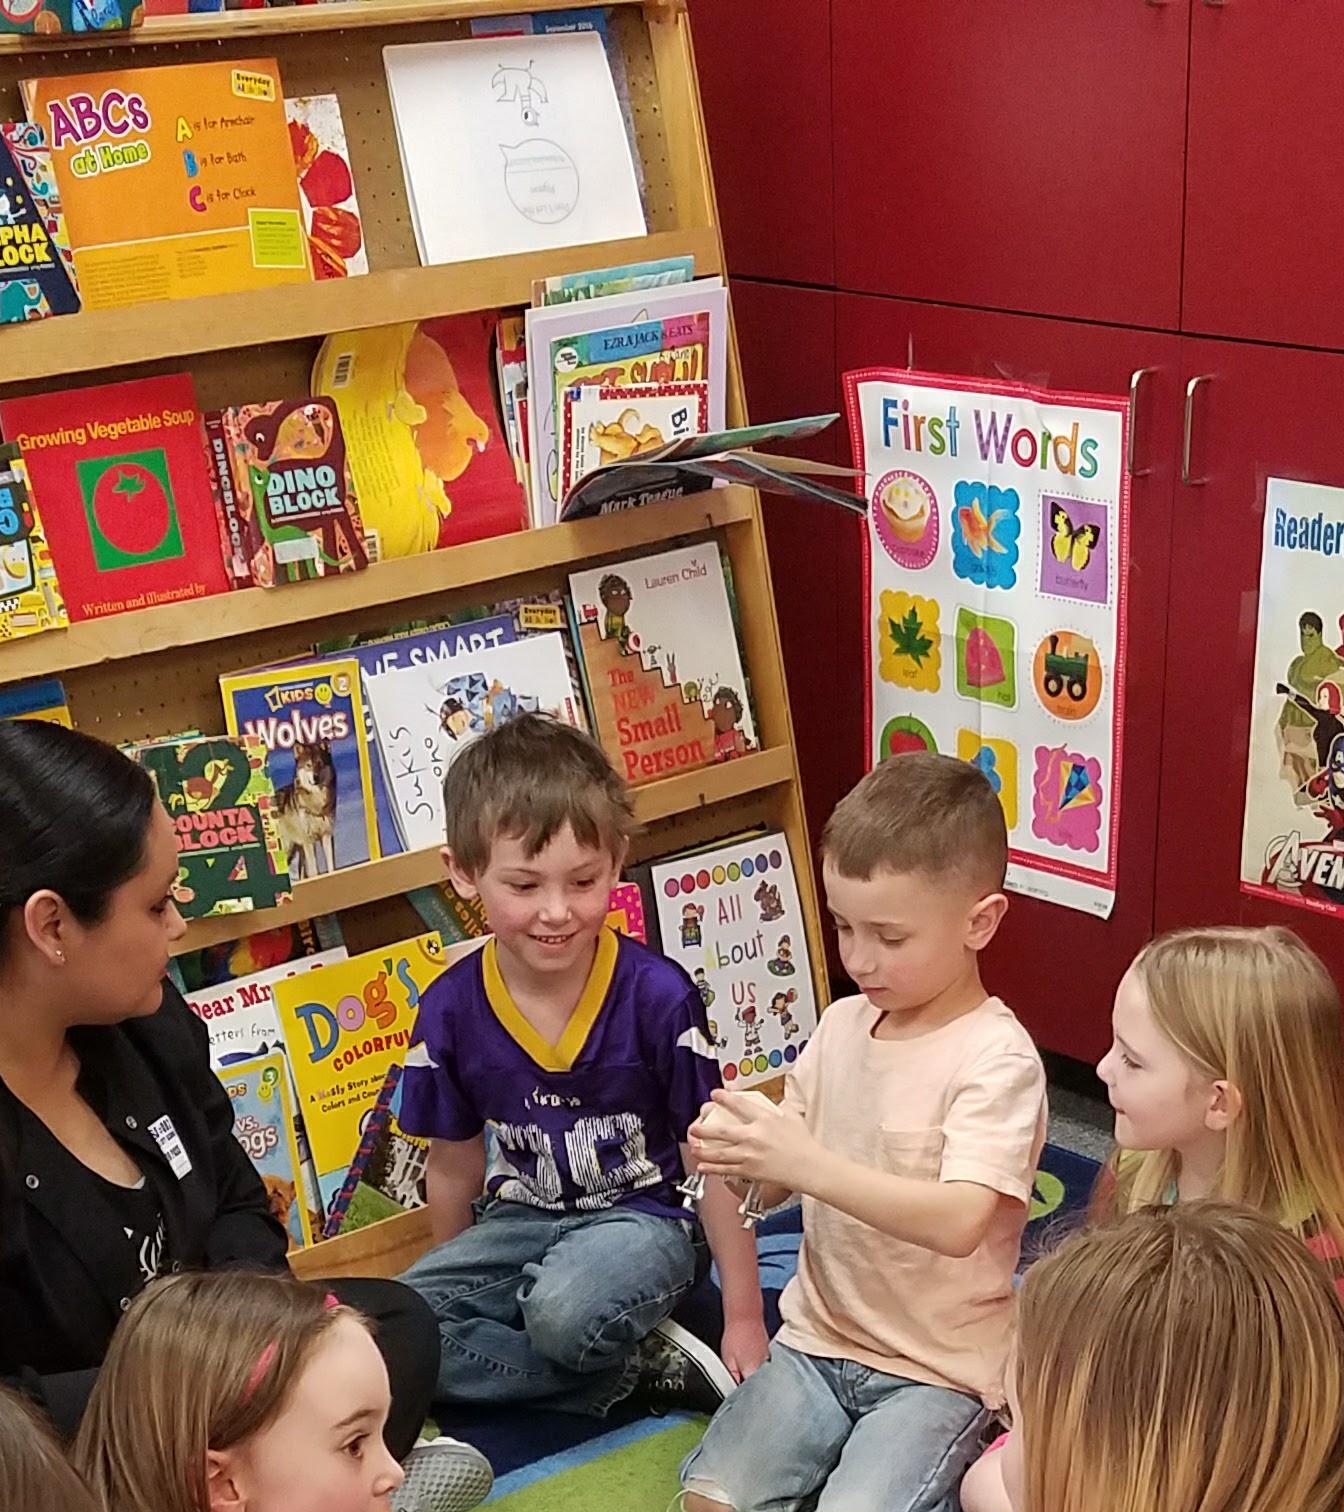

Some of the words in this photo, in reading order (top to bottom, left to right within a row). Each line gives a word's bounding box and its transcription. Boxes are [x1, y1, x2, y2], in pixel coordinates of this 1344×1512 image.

[235, 73, 272, 88] Everyday
[49, 91, 149, 148] ABCs
[176, 116, 193, 143] A
[203, 118, 218, 130] for
[220, 116, 256, 128] Armchair
[73, 150, 96, 175] at
[98, 143, 149, 169] Home
[183, 149, 198, 178] B
[209, 154, 225, 165] for
[226, 151, 248, 163] Bath
[189, 185, 207, 213] C
[216, 190, 231, 202] for
[232, 186, 257, 199] Clock
[603, 333, 632, 350] EZRA
[632, 329, 659, 345] JACK
[662, 323, 693, 341] KEATS
[16, 425, 86, 452] Growing
[86, 412, 161, 442] Vegetable
[162, 407, 196, 430] Soup
[671, 407, 690, 436] Bi
[881, 397, 960, 457] First
[972, 408, 1099, 479] Words
[266, 464, 336, 496] DINO
[268, 486, 342, 516] BLOCK
[600, 494, 637, 514] Mark
[638, 486, 684, 507] Teague
[644, 570, 680, 590] Lauren
[680, 562, 708, 583] Child
[1054, 574, 1090, 592] butterfly
[81, 599, 124, 617] Written
[125, 595, 145, 610] and
[193, 582, 207, 597] by
[523, 606, 557, 616] Everyday
[336, 676, 349, 691] 2
[607, 667, 635, 686] The
[902, 666, 919, 680] leaf
[280, 687, 314, 703] KIDS
[613, 685, 656, 715] NEW
[244, 709, 349, 750] Wolves
[616, 703, 682, 747] Small
[622, 740, 706, 781] Person
[718, 893, 743, 926] All
[705, 929, 765, 971] About
[187, 994, 236, 1020] Dear
[294, 957, 421, 1065] Dog's
[209, 1026, 245, 1046] etters
[250, 1022, 276, 1037] from
[266, 1070, 275, 1082] 3
[309, 1094, 316, 1103] A
[347, 1078, 369, 1092] Story
[370, 1073, 387, 1083] abou
[226, 1083, 247, 1099] DS
[321, 1099, 346, 1113] Colors
[347, 1094, 361, 1105] and
[241, 1124, 279, 1160] ogs
